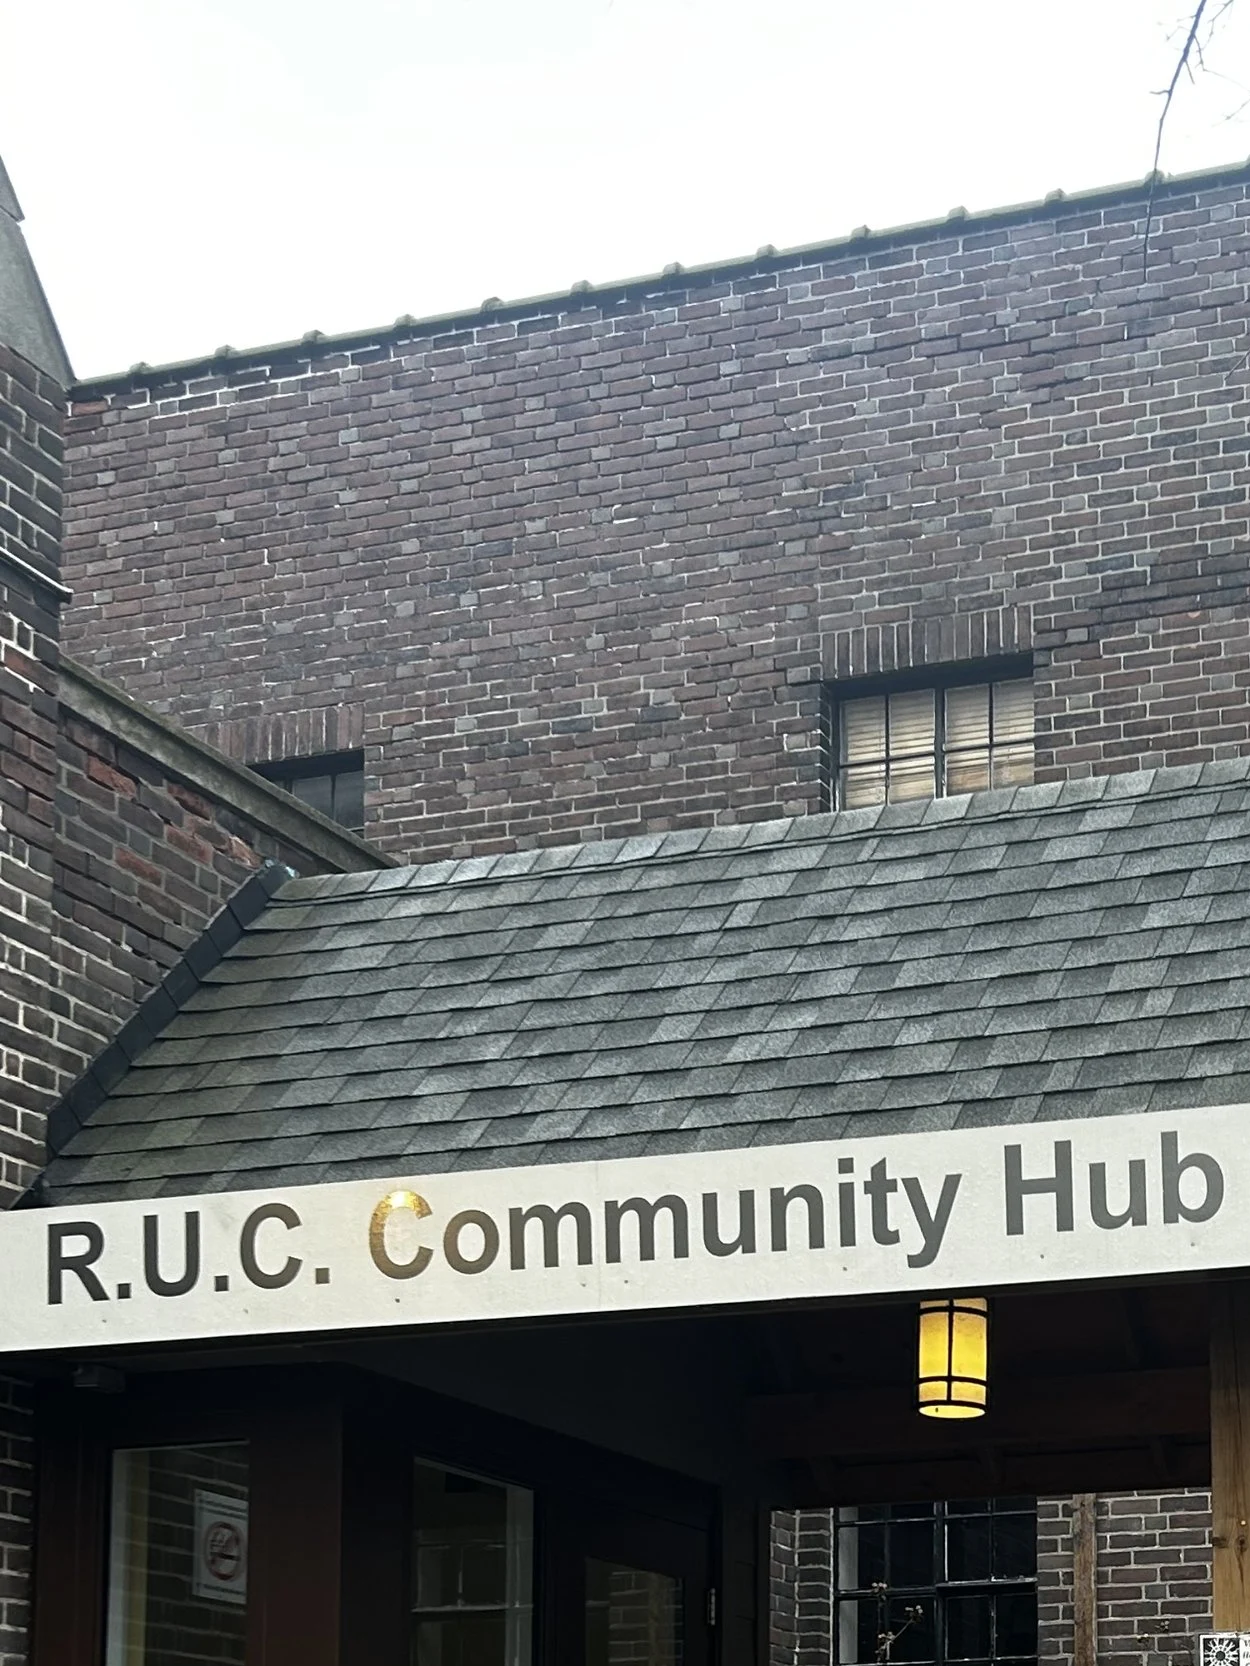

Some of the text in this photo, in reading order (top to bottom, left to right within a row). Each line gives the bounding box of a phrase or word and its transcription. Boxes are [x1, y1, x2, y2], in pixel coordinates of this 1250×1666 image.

[46, 1131, 1225, 1305] R.U.C. Community Hub
